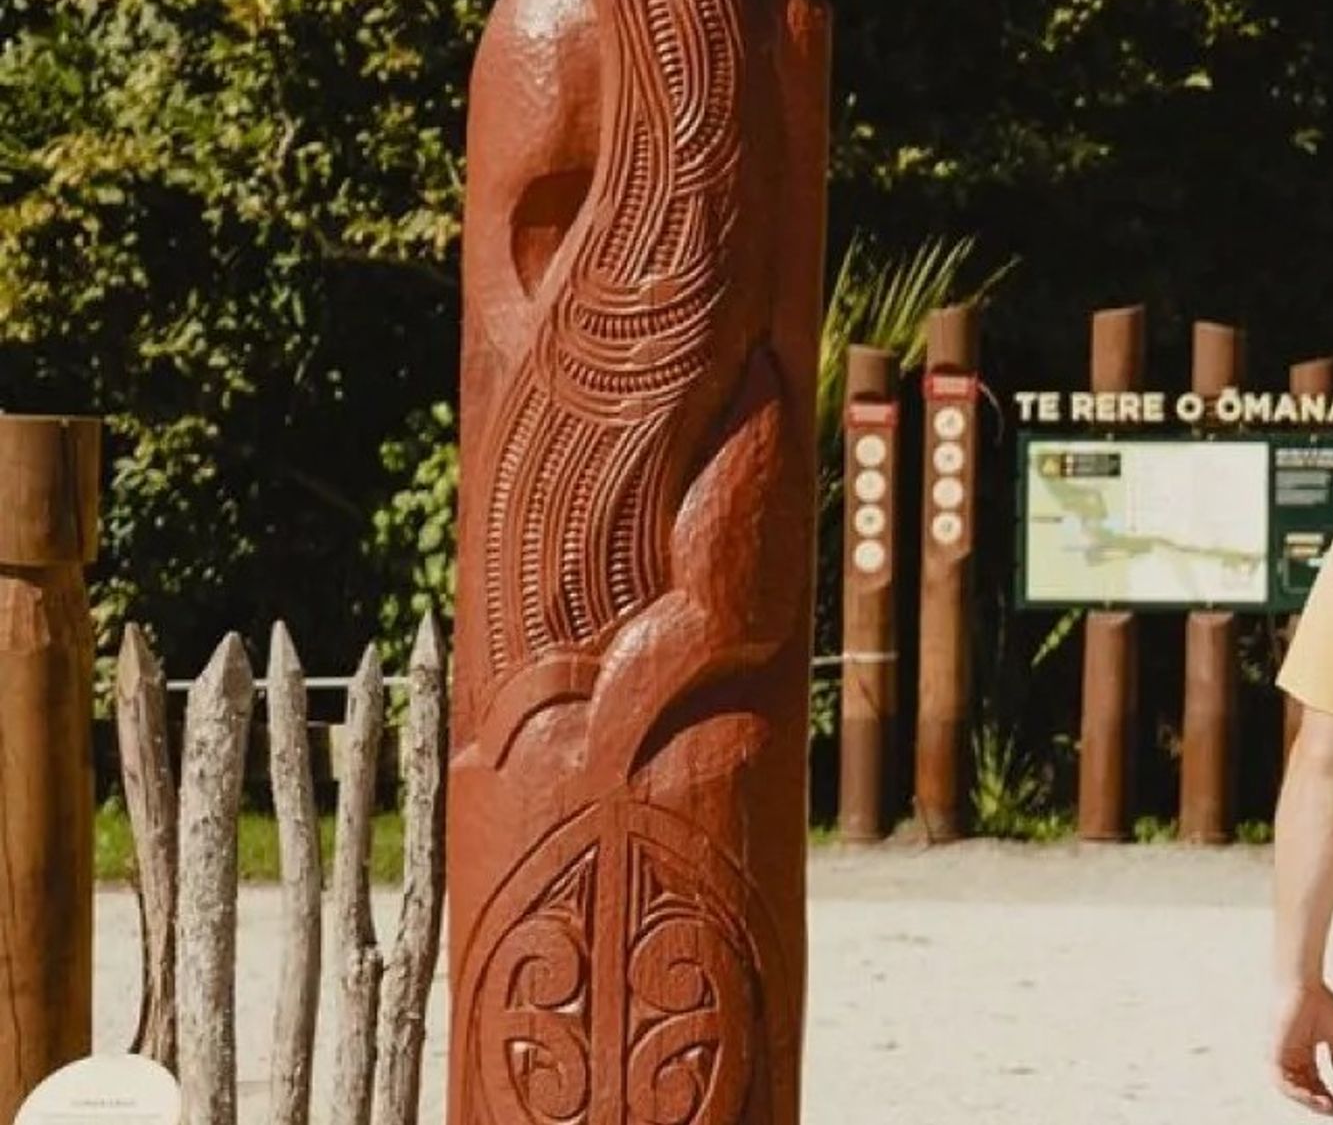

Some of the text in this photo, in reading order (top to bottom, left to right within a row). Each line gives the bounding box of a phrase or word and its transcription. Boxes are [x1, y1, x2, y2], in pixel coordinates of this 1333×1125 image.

[1015, 392, 1060, 422] TE
[1072, 392, 1165, 422] RERE
[1176, 392, 1205, 422] O
